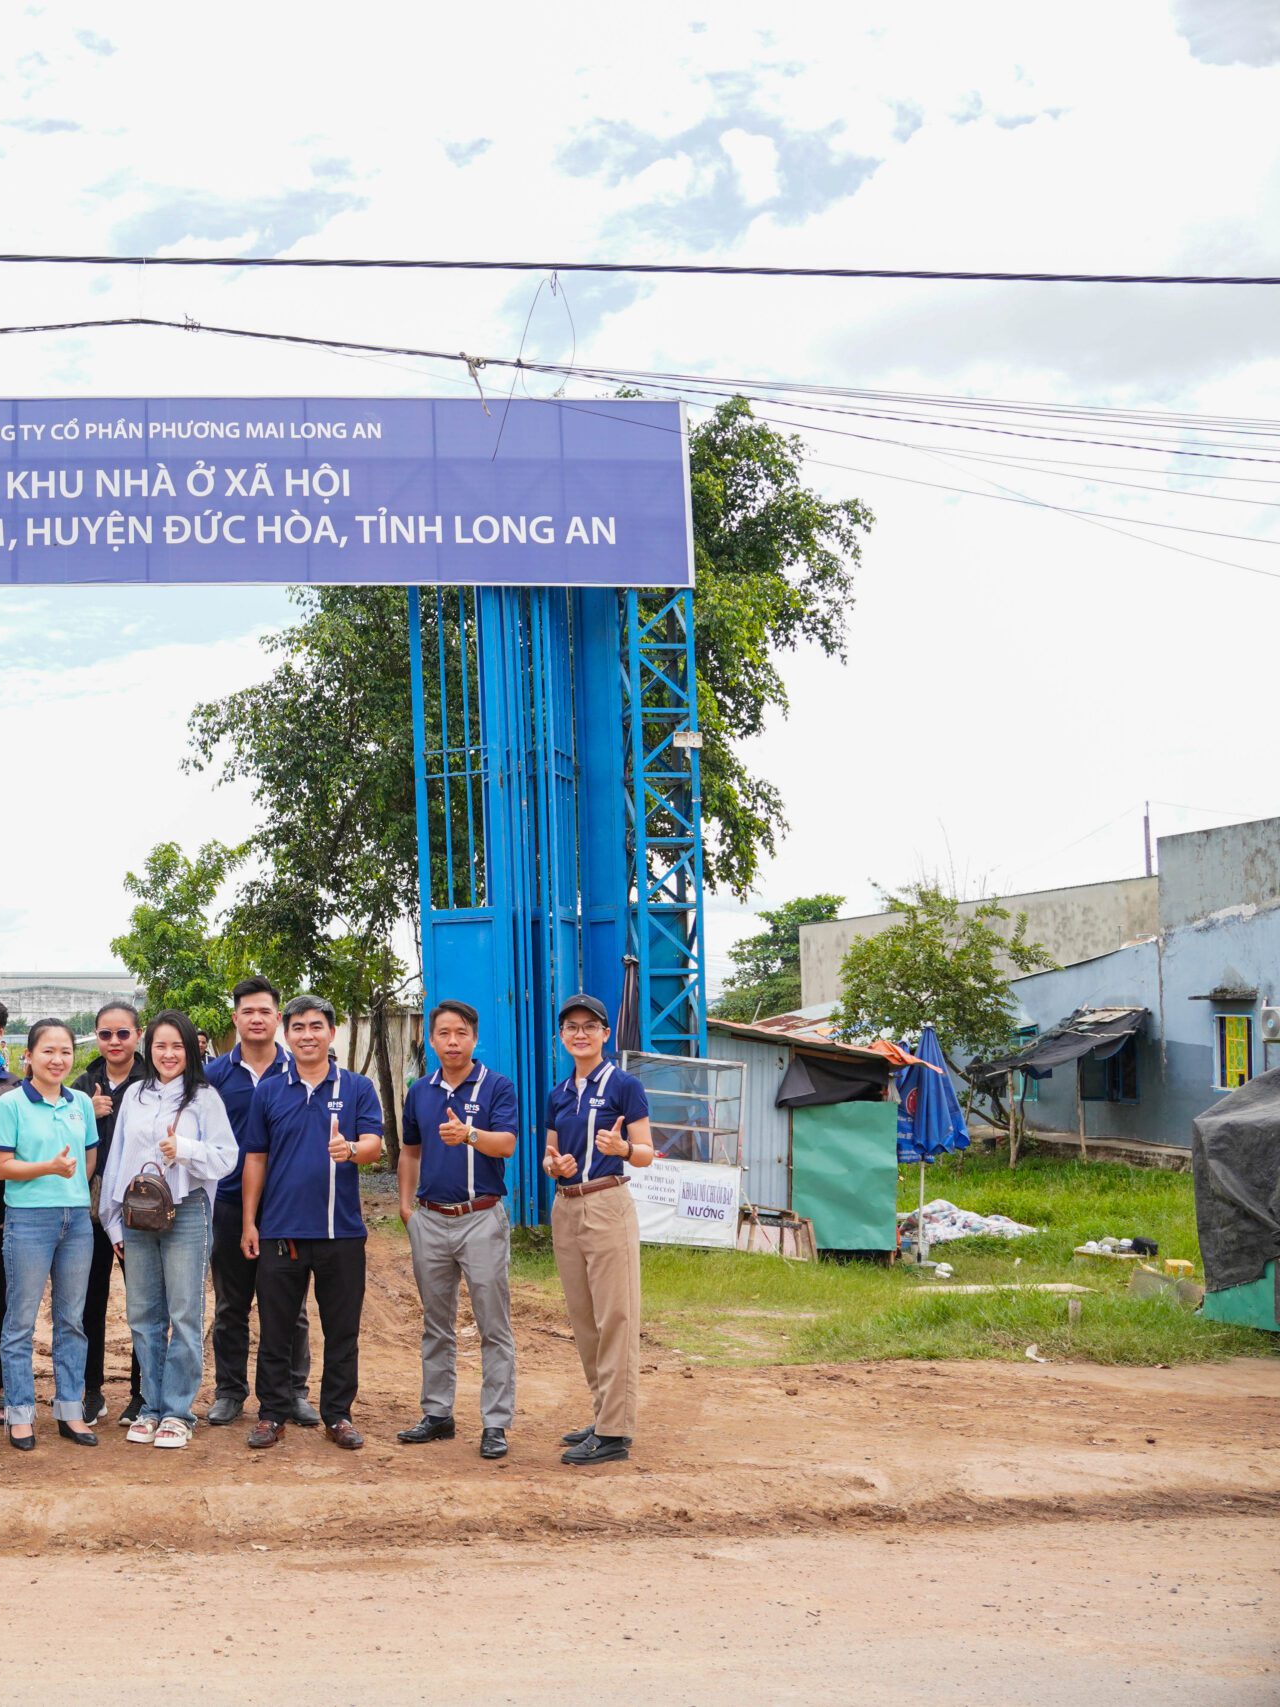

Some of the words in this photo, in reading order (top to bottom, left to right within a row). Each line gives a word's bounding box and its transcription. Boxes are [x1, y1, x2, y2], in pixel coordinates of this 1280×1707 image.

[19, 423, 47, 441] TY
[50, 417, 80, 440] CỔ
[85, 417, 143, 439] PHẦN
[148, 419, 240, 439] PHƯƠNG
[245, 421, 284, 439] MAI
[290, 421, 347, 439] LONG
[352, 422, 382, 439] AN
[7, 469, 84, 500] KHU
[95, 462, 177, 498] NHÀ
[186, 459, 216, 497] Ở
[224, 462, 275, 497] XÃ
[285, 462, 350, 505] HỘI
[26, 510, 153, 553] HUYỆN
[162, 509, 246, 545] ĐỨC
[257, 509, 349, 549] HÒA,
[354, 506, 443, 544] TỈNH
[455, 515, 555, 545] LONG
[565, 516, 617, 545] AN
[464, 1103, 480, 1112] BMS
[687, 1205, 725, 1220] NƯỚNG
